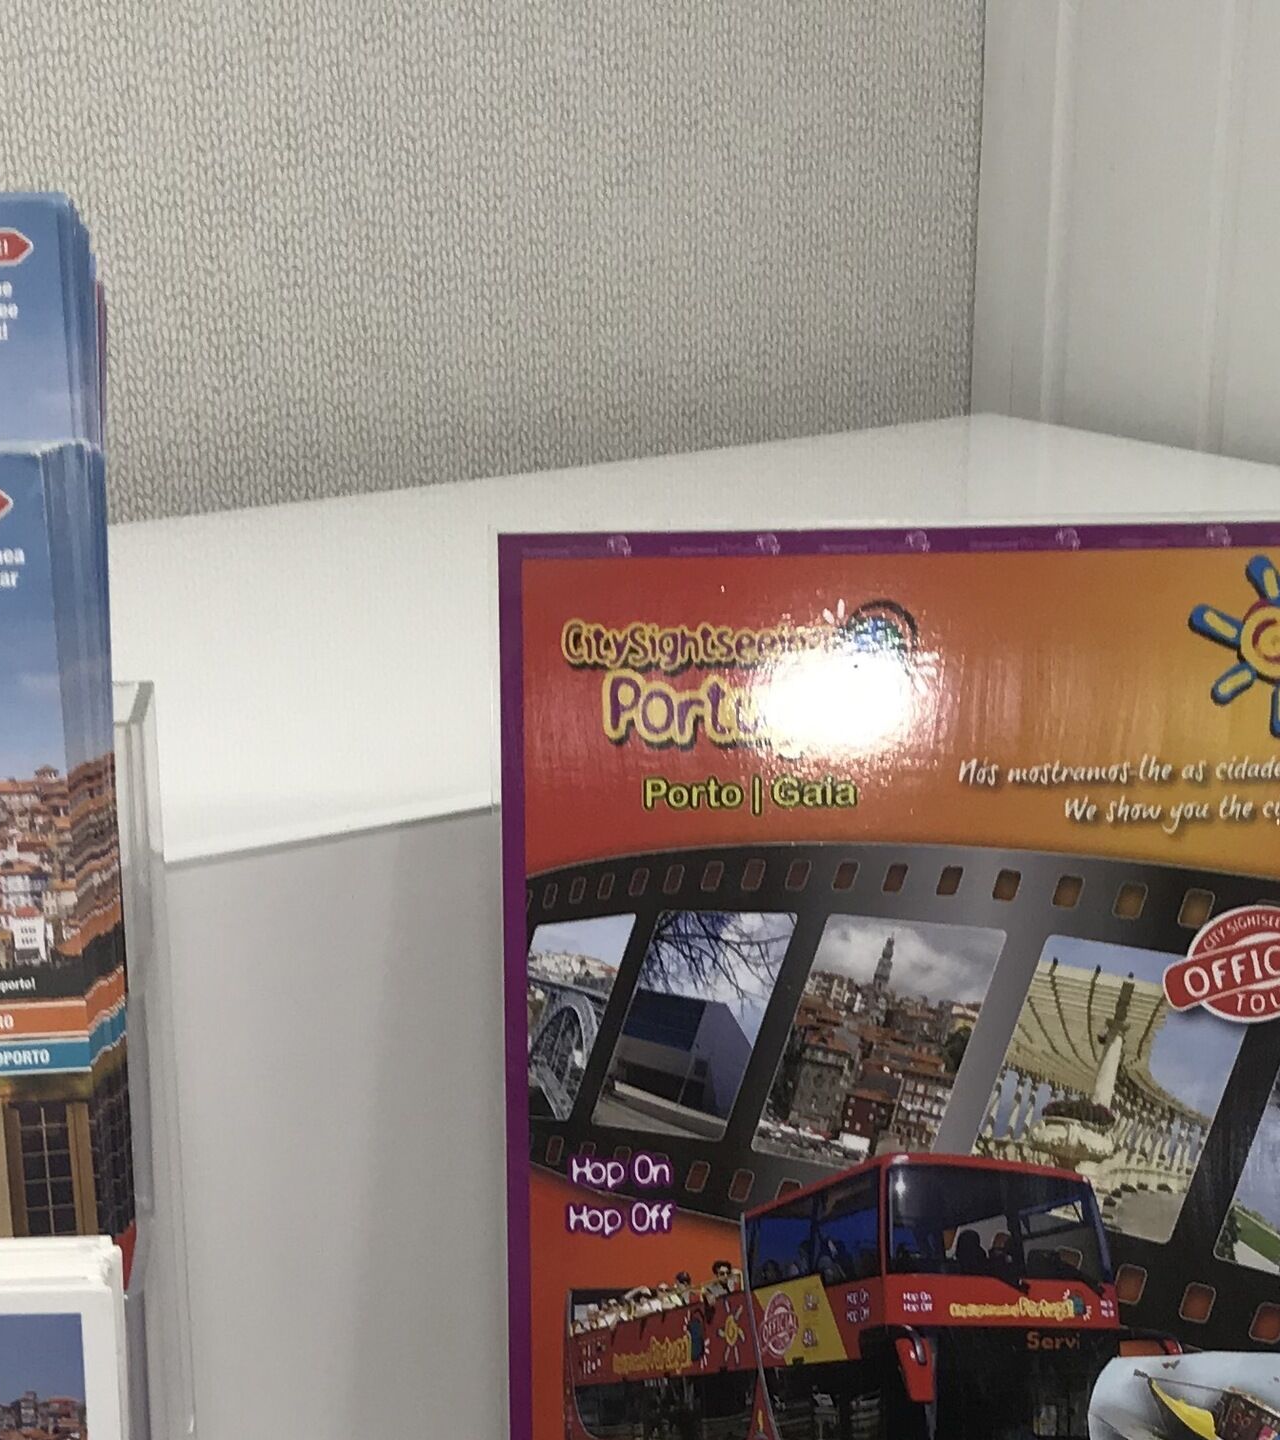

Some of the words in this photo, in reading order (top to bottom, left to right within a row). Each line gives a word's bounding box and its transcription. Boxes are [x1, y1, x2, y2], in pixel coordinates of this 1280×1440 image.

[1182, 760, 1206, 782] as
[644, 777, 744, 809] Porto
[772, 775, 858, 808] Gaia
[1065, 796, 1096, 821] We
[1106, 795, 1163, 823] show
[1163, 803, 1209, 834] you
[1219, 795, 1252, 820] the
[1203, 928, 1226, 950] CITY
[572, 1157, 624, 1188] Hop
[634, 1154, 669, 1184] On
[569, 1205, 622, 1236] Hop
[631, 1202, 673, 1232] Off
